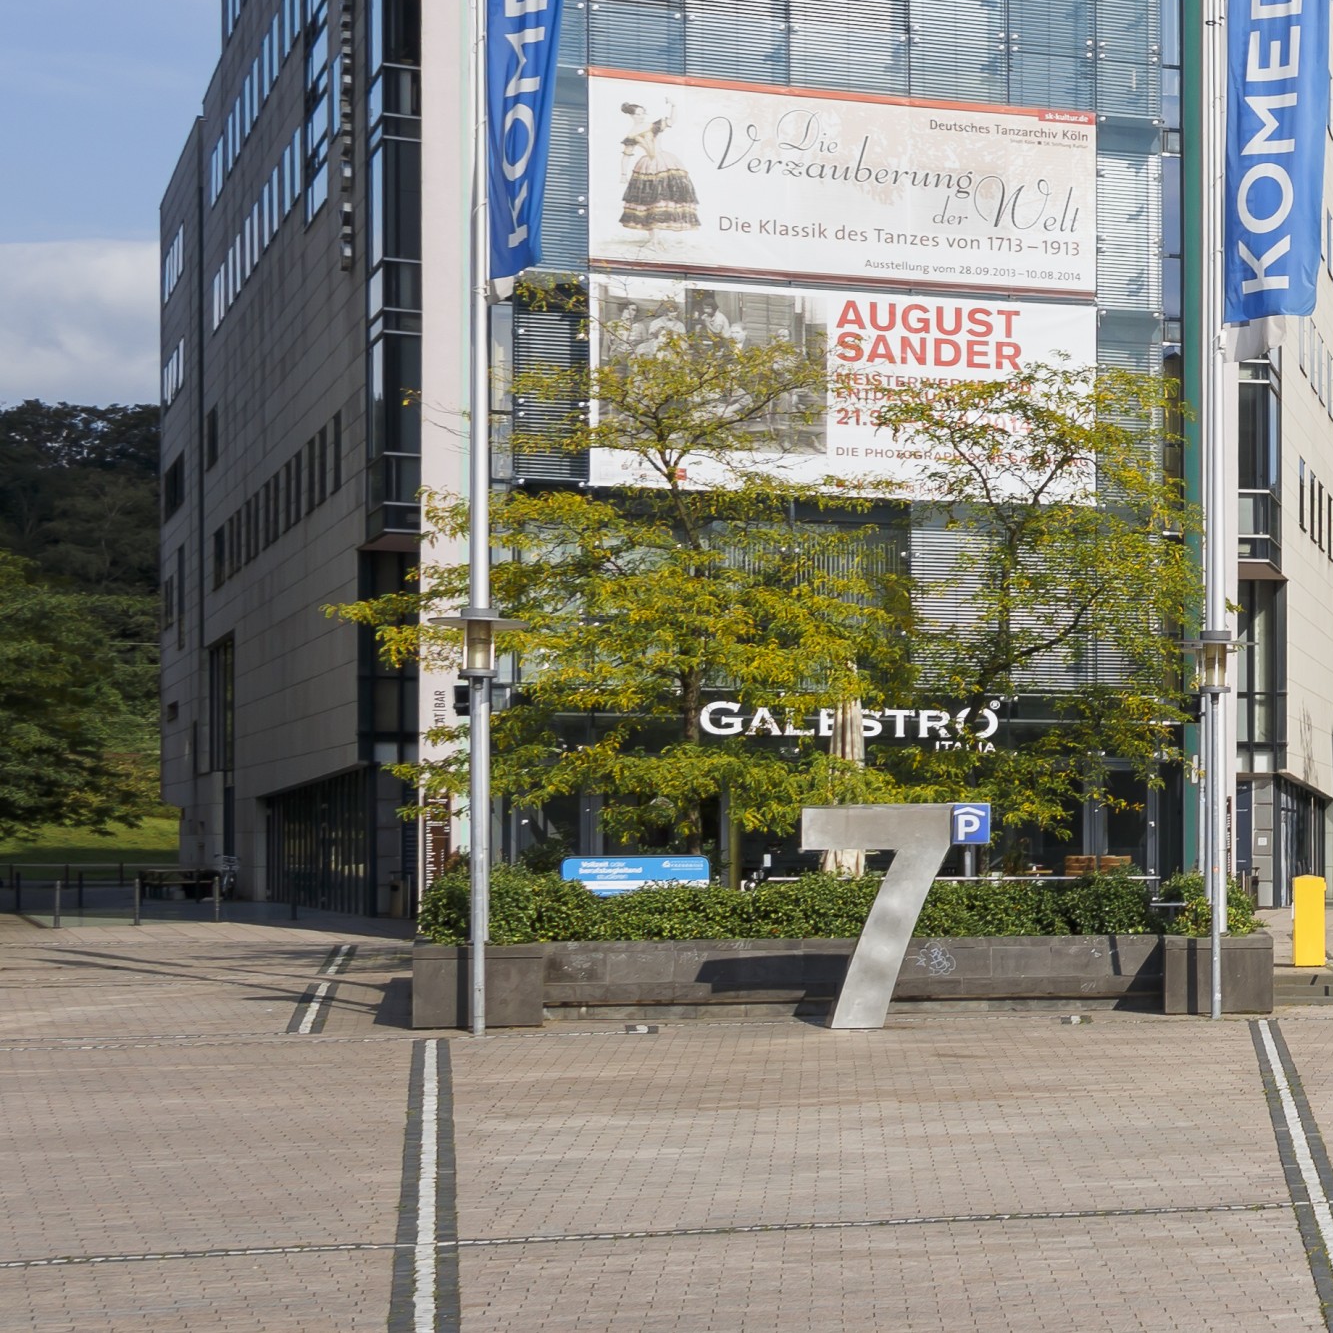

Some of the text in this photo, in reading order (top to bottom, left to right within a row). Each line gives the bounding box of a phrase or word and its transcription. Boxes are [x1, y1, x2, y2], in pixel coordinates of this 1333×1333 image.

[777, 109, 838, 153] Die
[930, 119, 1088, 142] Deutsches Tanzarchiv Köln
[703, 116, 974, 199] Verzauberung
[932, 175, 1079, 233] der Welt
[719, 216, 751, 233] Die
[758, 219, 828, 240] Klassik
[834, 225, 867, 242] des
[873, 228, 939, 247] Tanzes
[946, 237, 980, 250] von
[864, 259, 929, 275] Ausstellung
[932, 265, 956, 274] vom
[836, 299, 1021, 339] AUGUST
[836, 331, 1022, 371] SANDER
[836, 447, 859, 457] DIE
[935, 740, 997, 753] ITAIA
[957, 814, 981, 841] P
[802, 804, 952, 1029] 7
